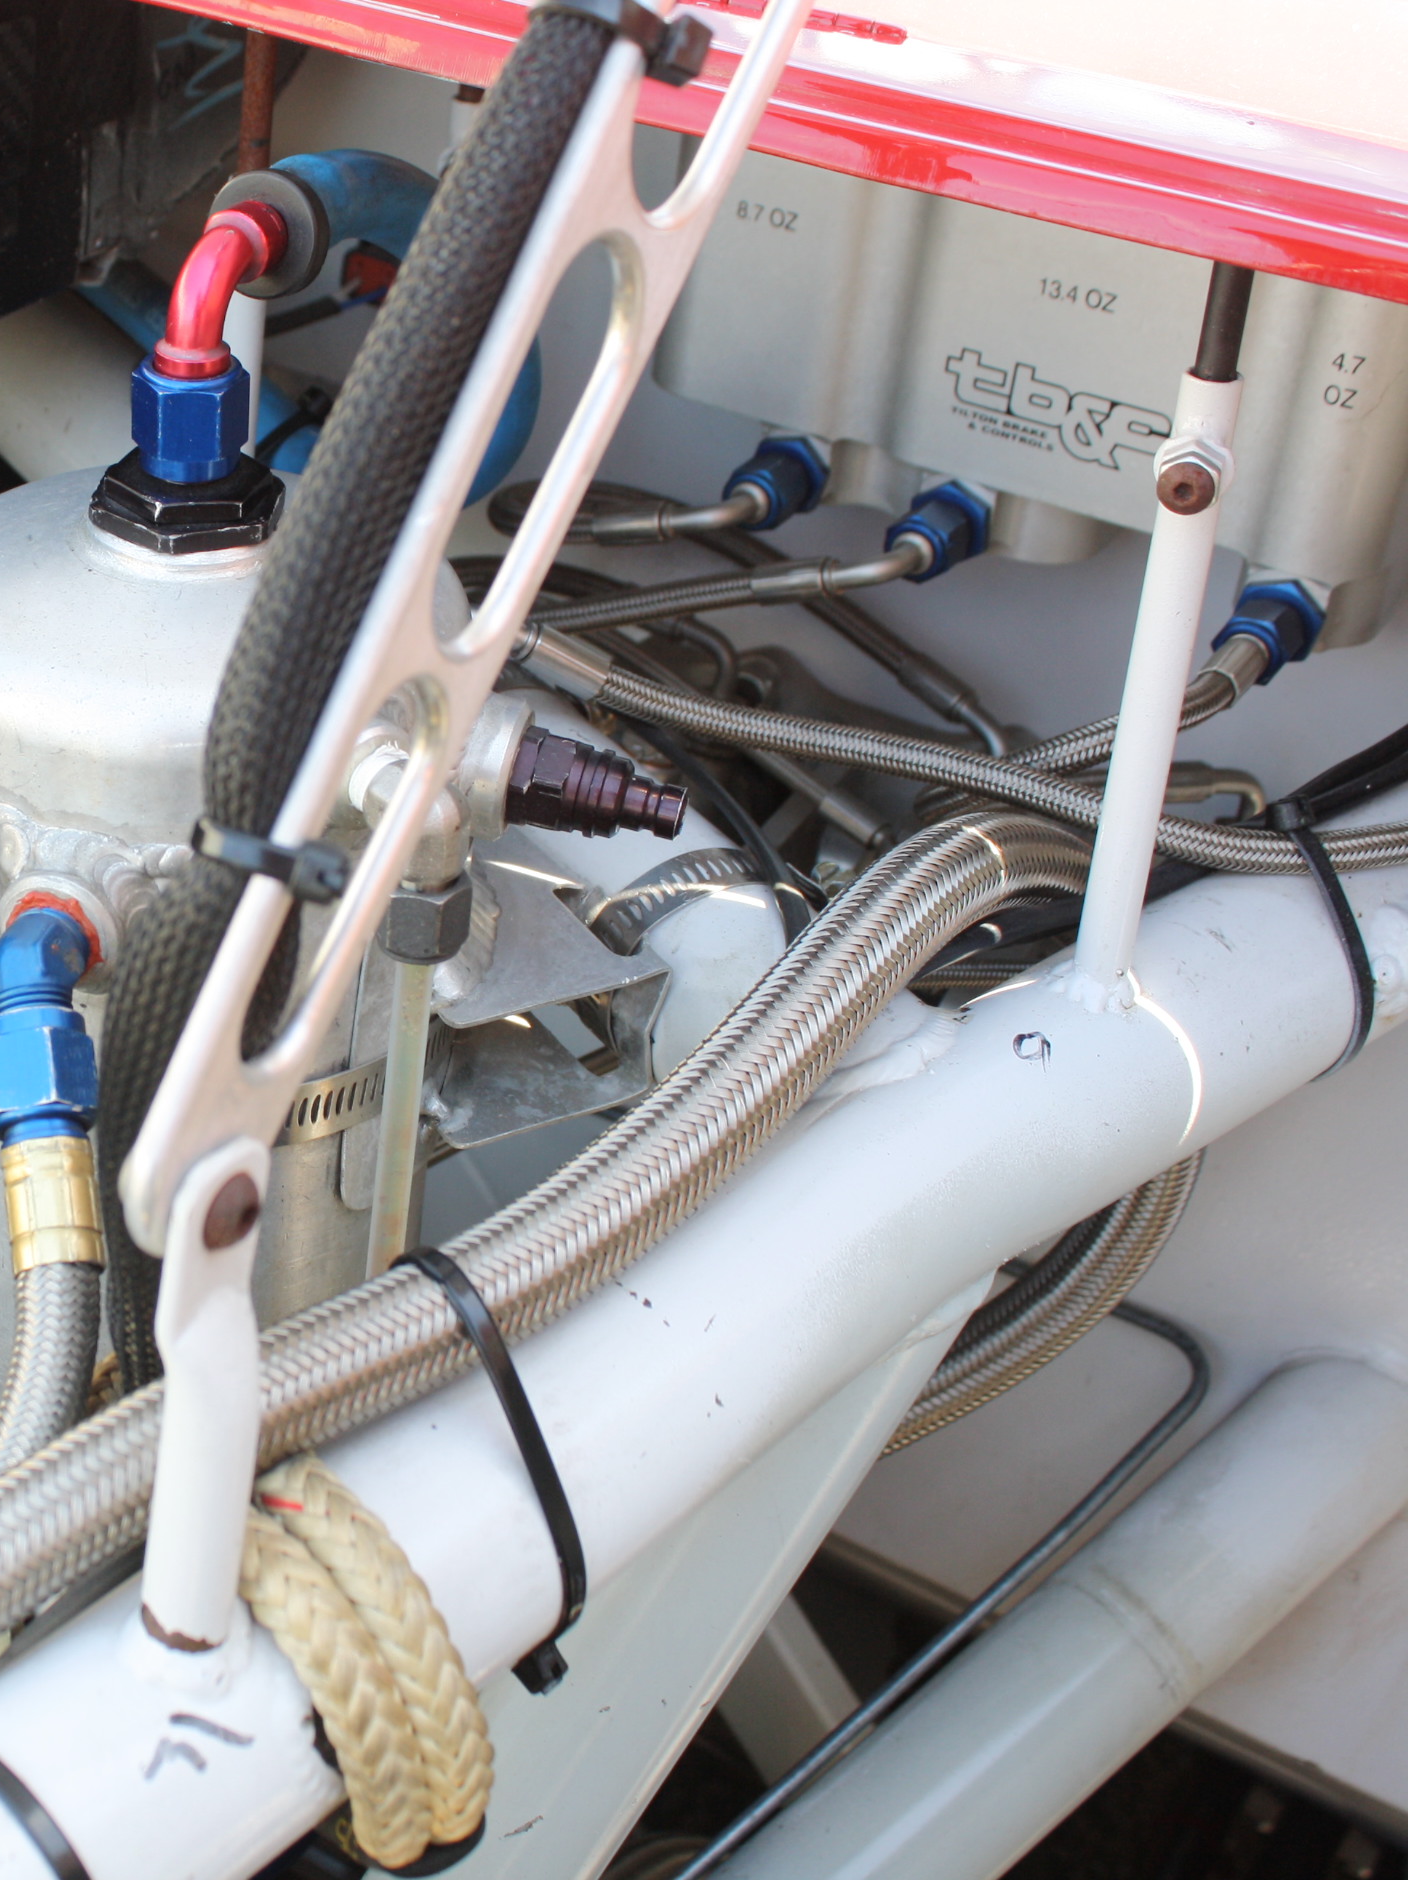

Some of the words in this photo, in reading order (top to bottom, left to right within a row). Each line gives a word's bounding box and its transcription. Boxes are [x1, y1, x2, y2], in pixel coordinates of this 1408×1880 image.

[769, 207, 799, 232] OZ
[1040, 277, 1079, 304] 13.4
[1085, 287, 1118, 314] OZ
[1332, 353, 1367, 375] 4.7
[1323, 384, 1358, 410] OZ
[951, 405, 998, 425] TILTON
[981, 424, 1054, 452] CONTROLS
